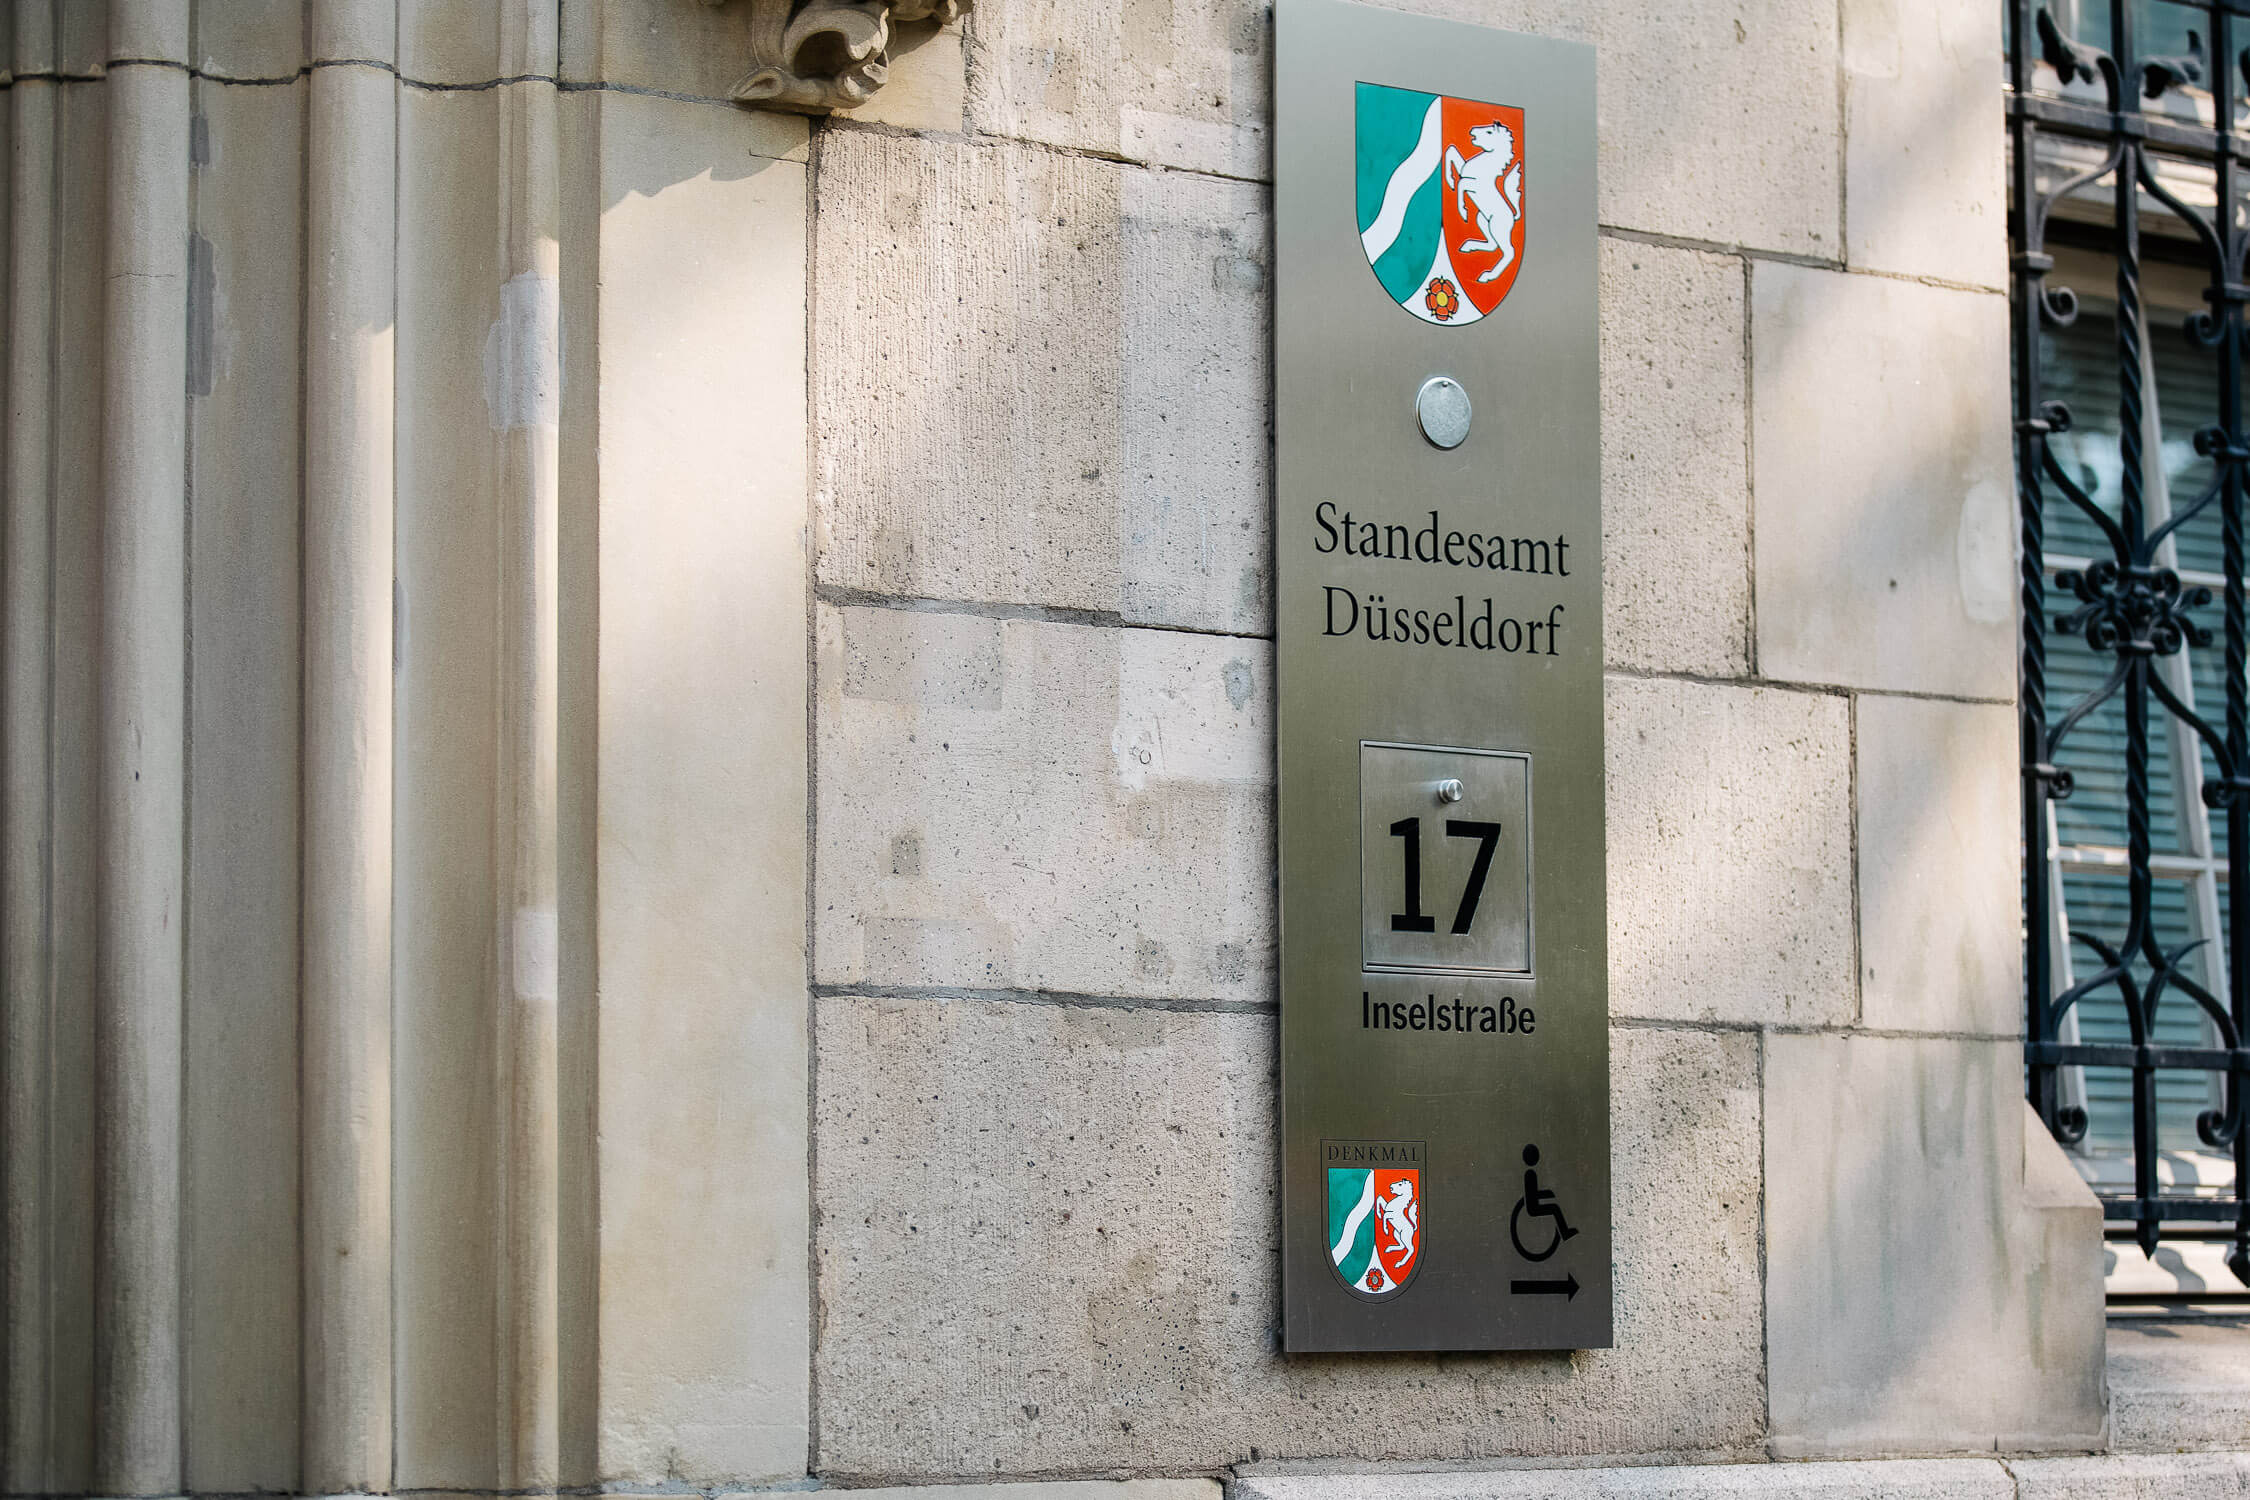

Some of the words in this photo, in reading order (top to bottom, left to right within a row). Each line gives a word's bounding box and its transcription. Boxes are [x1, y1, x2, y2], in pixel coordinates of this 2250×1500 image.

[1314, 501, 1571, 577] Standesamt
[1321, 585, 1565, 656] Düsseldorf
[1389, 816, 1502, 935] 17
[1362, 991, 1536, 1035] Inselstraße
[1327, 1145, 1421, 1162] DENKMAL
